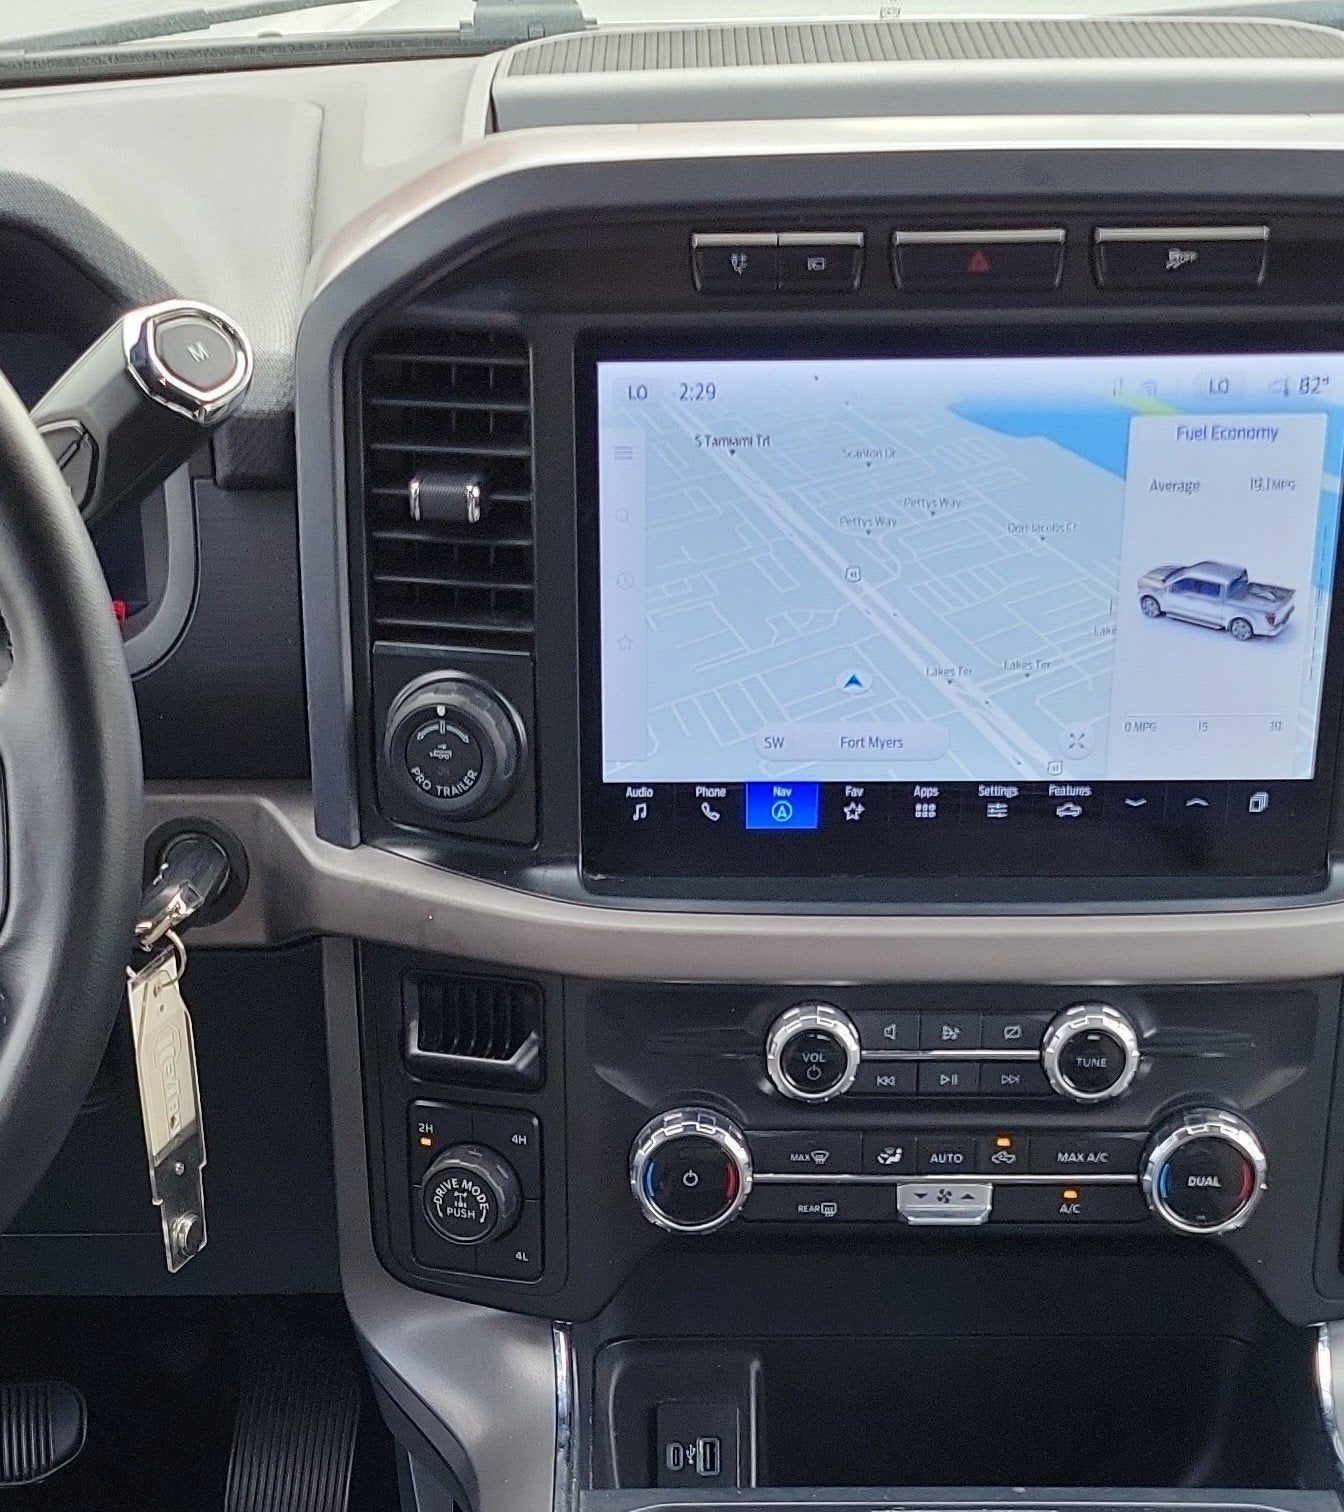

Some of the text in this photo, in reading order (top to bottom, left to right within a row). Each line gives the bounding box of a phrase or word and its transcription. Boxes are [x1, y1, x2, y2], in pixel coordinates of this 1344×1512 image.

[187, 341, 210, 362] M
[627, 384, 648, 400] LO
[679, 382, 716, 401] 2:29
[1208, 378, 1230, 395] LO
[1176, 424, 1278, 443] Fuel Economy
[1149, 479, 1201, 494] Average
[764, 737, 784, 749] SW
[840, 736, 903, 750] Fort Myers
[411, 767, 478, 797] PRO TRAILER
[626, 786, 654, 798] Audio
[695, 786, 726, 798] Phone
[773, 786, 792, 797] Nav
[845, 786, 864, 798] Fav
[913, 785, 939, 799] Apps
[978, 785, 1019, 799] Settings
[1048, 784, 1092, 797] Features
[802, 1052, 826, 1062] VOL
[1076, 1057, 1107, 1068] TUNE
[418, 1123, 434, 1133] 2H
[511, 1134, 527, 1145] 4H
[790, 1153, 811, 1162] MAX
[930, 1153, 964, 1164] AUTO
[1057, 1152, 1109, 1164] MAX A/C
[1187, 1175, 1221, 1188] DUAL
[433, 1178, 490, 1210] DRIVE MODE
[446, 1206, 476, 1219] PUSH
[798, 1204, 820, 1213] REAR
[1060, 1203, 1081, 1214] A/C
[515, 1251, 529, 1261] 4L
